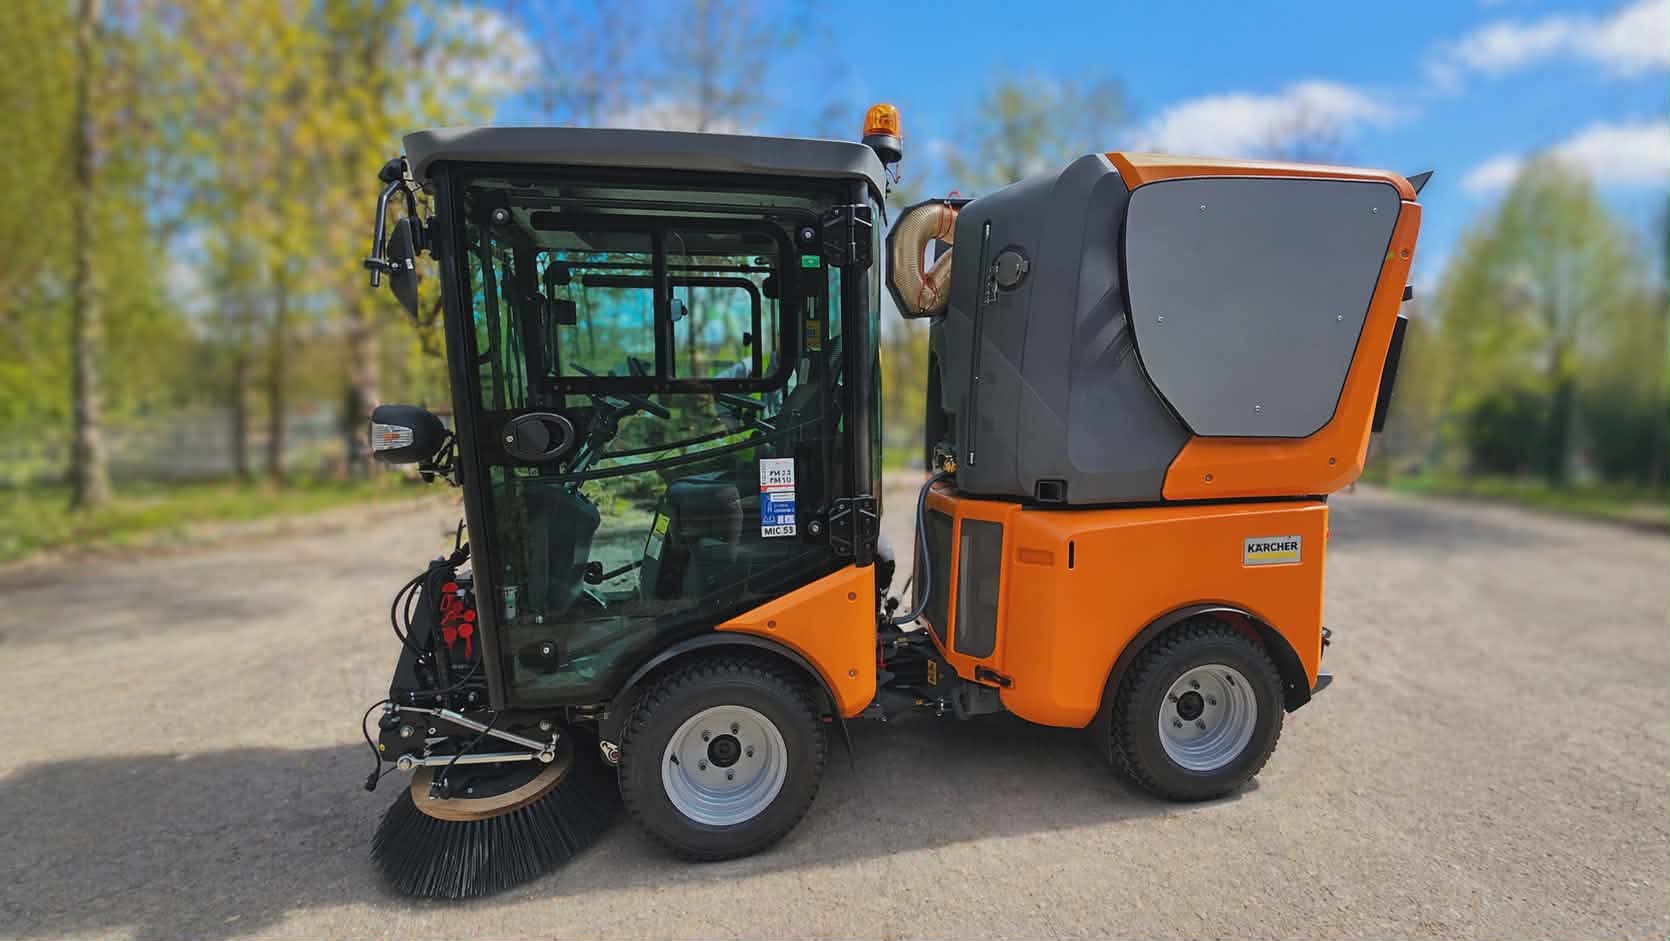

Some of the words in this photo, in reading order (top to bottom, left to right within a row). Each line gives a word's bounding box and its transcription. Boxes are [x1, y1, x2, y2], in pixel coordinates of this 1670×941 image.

[764, 526, 781, 536] MIC
[783, 526, 793, 534] 53
[1248, 541, 1298, 552] KÄRCHER
